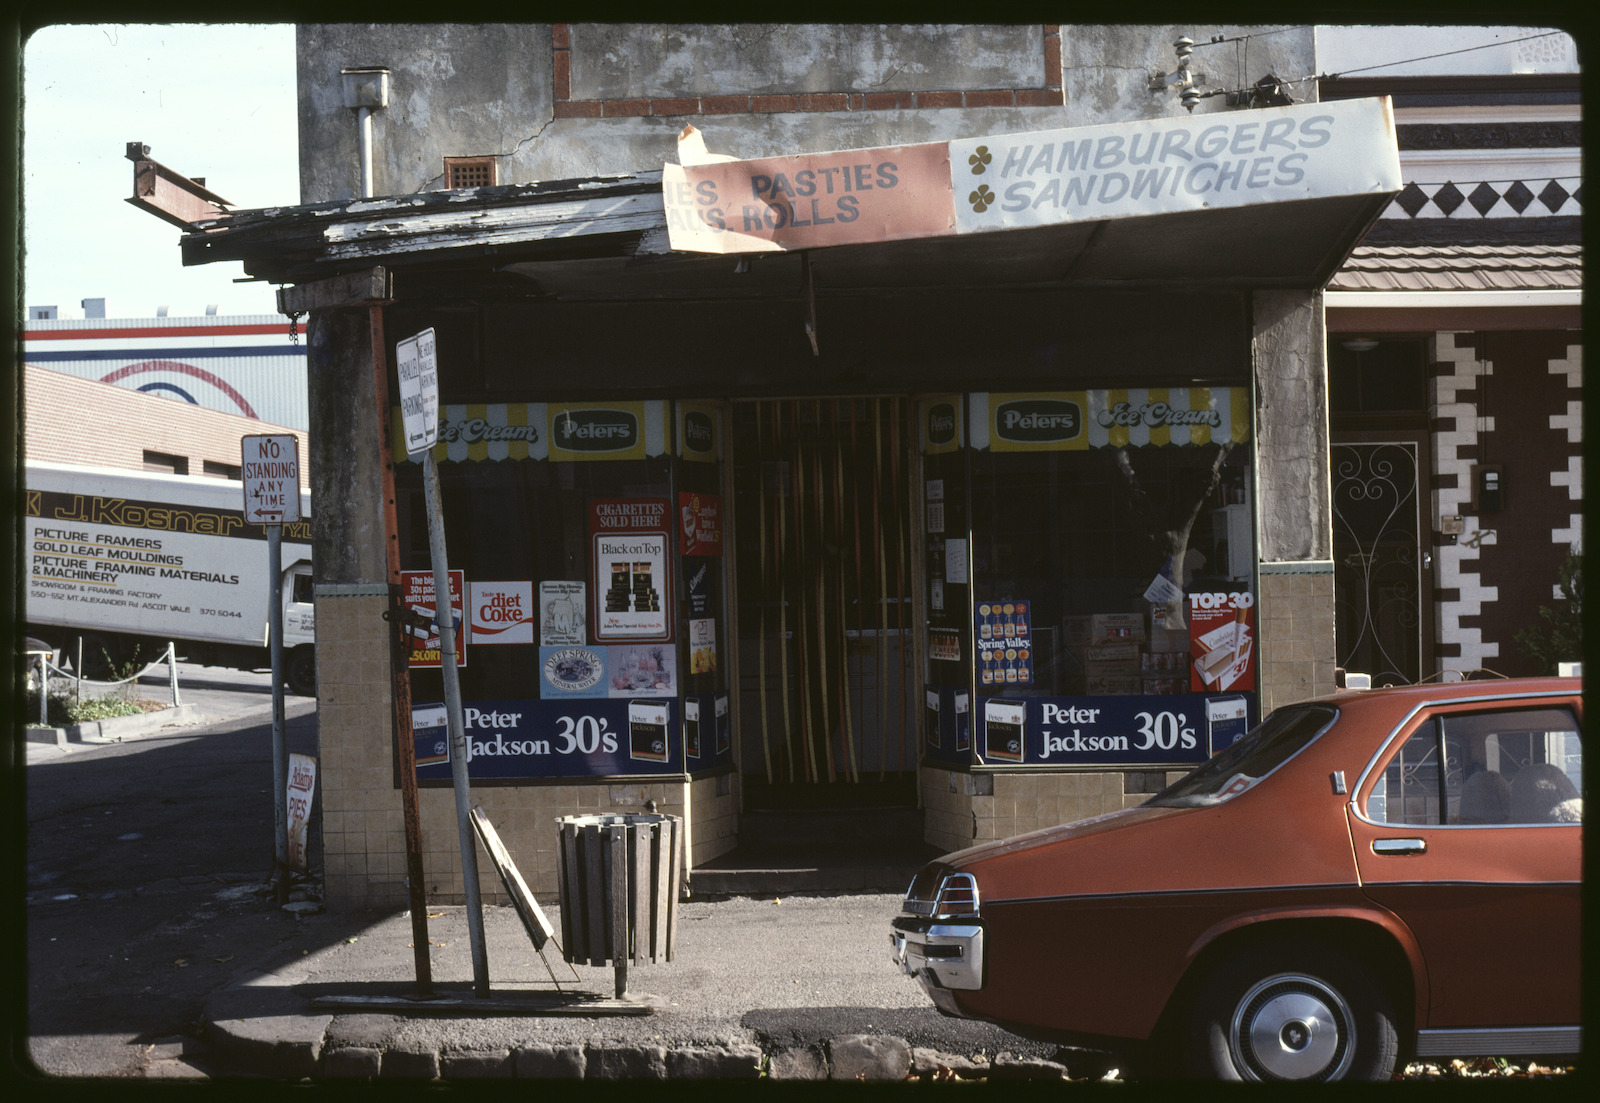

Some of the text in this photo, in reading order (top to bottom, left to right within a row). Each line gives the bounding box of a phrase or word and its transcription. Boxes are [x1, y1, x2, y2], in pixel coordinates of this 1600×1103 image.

[1001, 115, 1335, 178] HAMBURGERS
[751, 162, 898, 200] PASTIES
[1001, 152, 1308, 212] SANDWICHES
[743, 196, 860, 232] ROLLS
[931, 414, 953, 432] Peters
[1004, 410, 1074, 429] Peters
[1098, 402, 1221, 428] Ice Cream
[458, 418, 538, 443] Cream
[561, 420, 630, 440] Peters
[688, 419, 710, 441] Peters
[259, 442, 280, 458] NO
[246, 462, 296, 479] STANDING
[259, 480, 284, 492] ANY
[260, 494, 286, 505] TIME
[596, 503, 664, 516] CIGARETTES
[600, 516, 660, 528] SOLD HERE
[34, 527, 162, 550] PICTURE FRAMERS
[33, 541, 184, 566] GOLD LEAF MOULDINGS
[602, 543, 661, 555] Black on Top
[32, 565, 118, 582] & MACHINERY
[33, 555, 240, 585] PICTURE FRAMING MATERIALS
[31, 580, 76, 591] SHOWROOM
[88, 586, 124, 596] FRAMING
[128, 590, 162, 599] FACTORY
[411, 576, 423, 584] The
[30, 590, 64, 600] 550-552
[80, 596, 126, 606] ALEXANDER
[142, 602, 168, 611] ASCOT
[170, 605, 190, 613] VALE
[218, 610, 242, 618] 5044
[405, 594, 421, 602] suits
[492, 592, 521, 607] diet
[1188, 592, 1254, 609] TOP 30
[480, 605, 522, 622] Coke
[978, 638, 1005, 650] Spring
[546, 649, 601, 668] DEEP SPRING
[553, 677, 596, 689] MINERAL WATER
[464, 708, 522, 729] Peter
[1042, 703, 1100, 724] Peter
[414, 720, 429, 728] Peter
[632, 724, 656, 732] Jackson
[464, 734, 551, 763] Jackson
[555, 715, 619, 754] 30's
[1039, 711, 1197, 759] Jackson 30's
[288, 797, 306, 820] PIES
